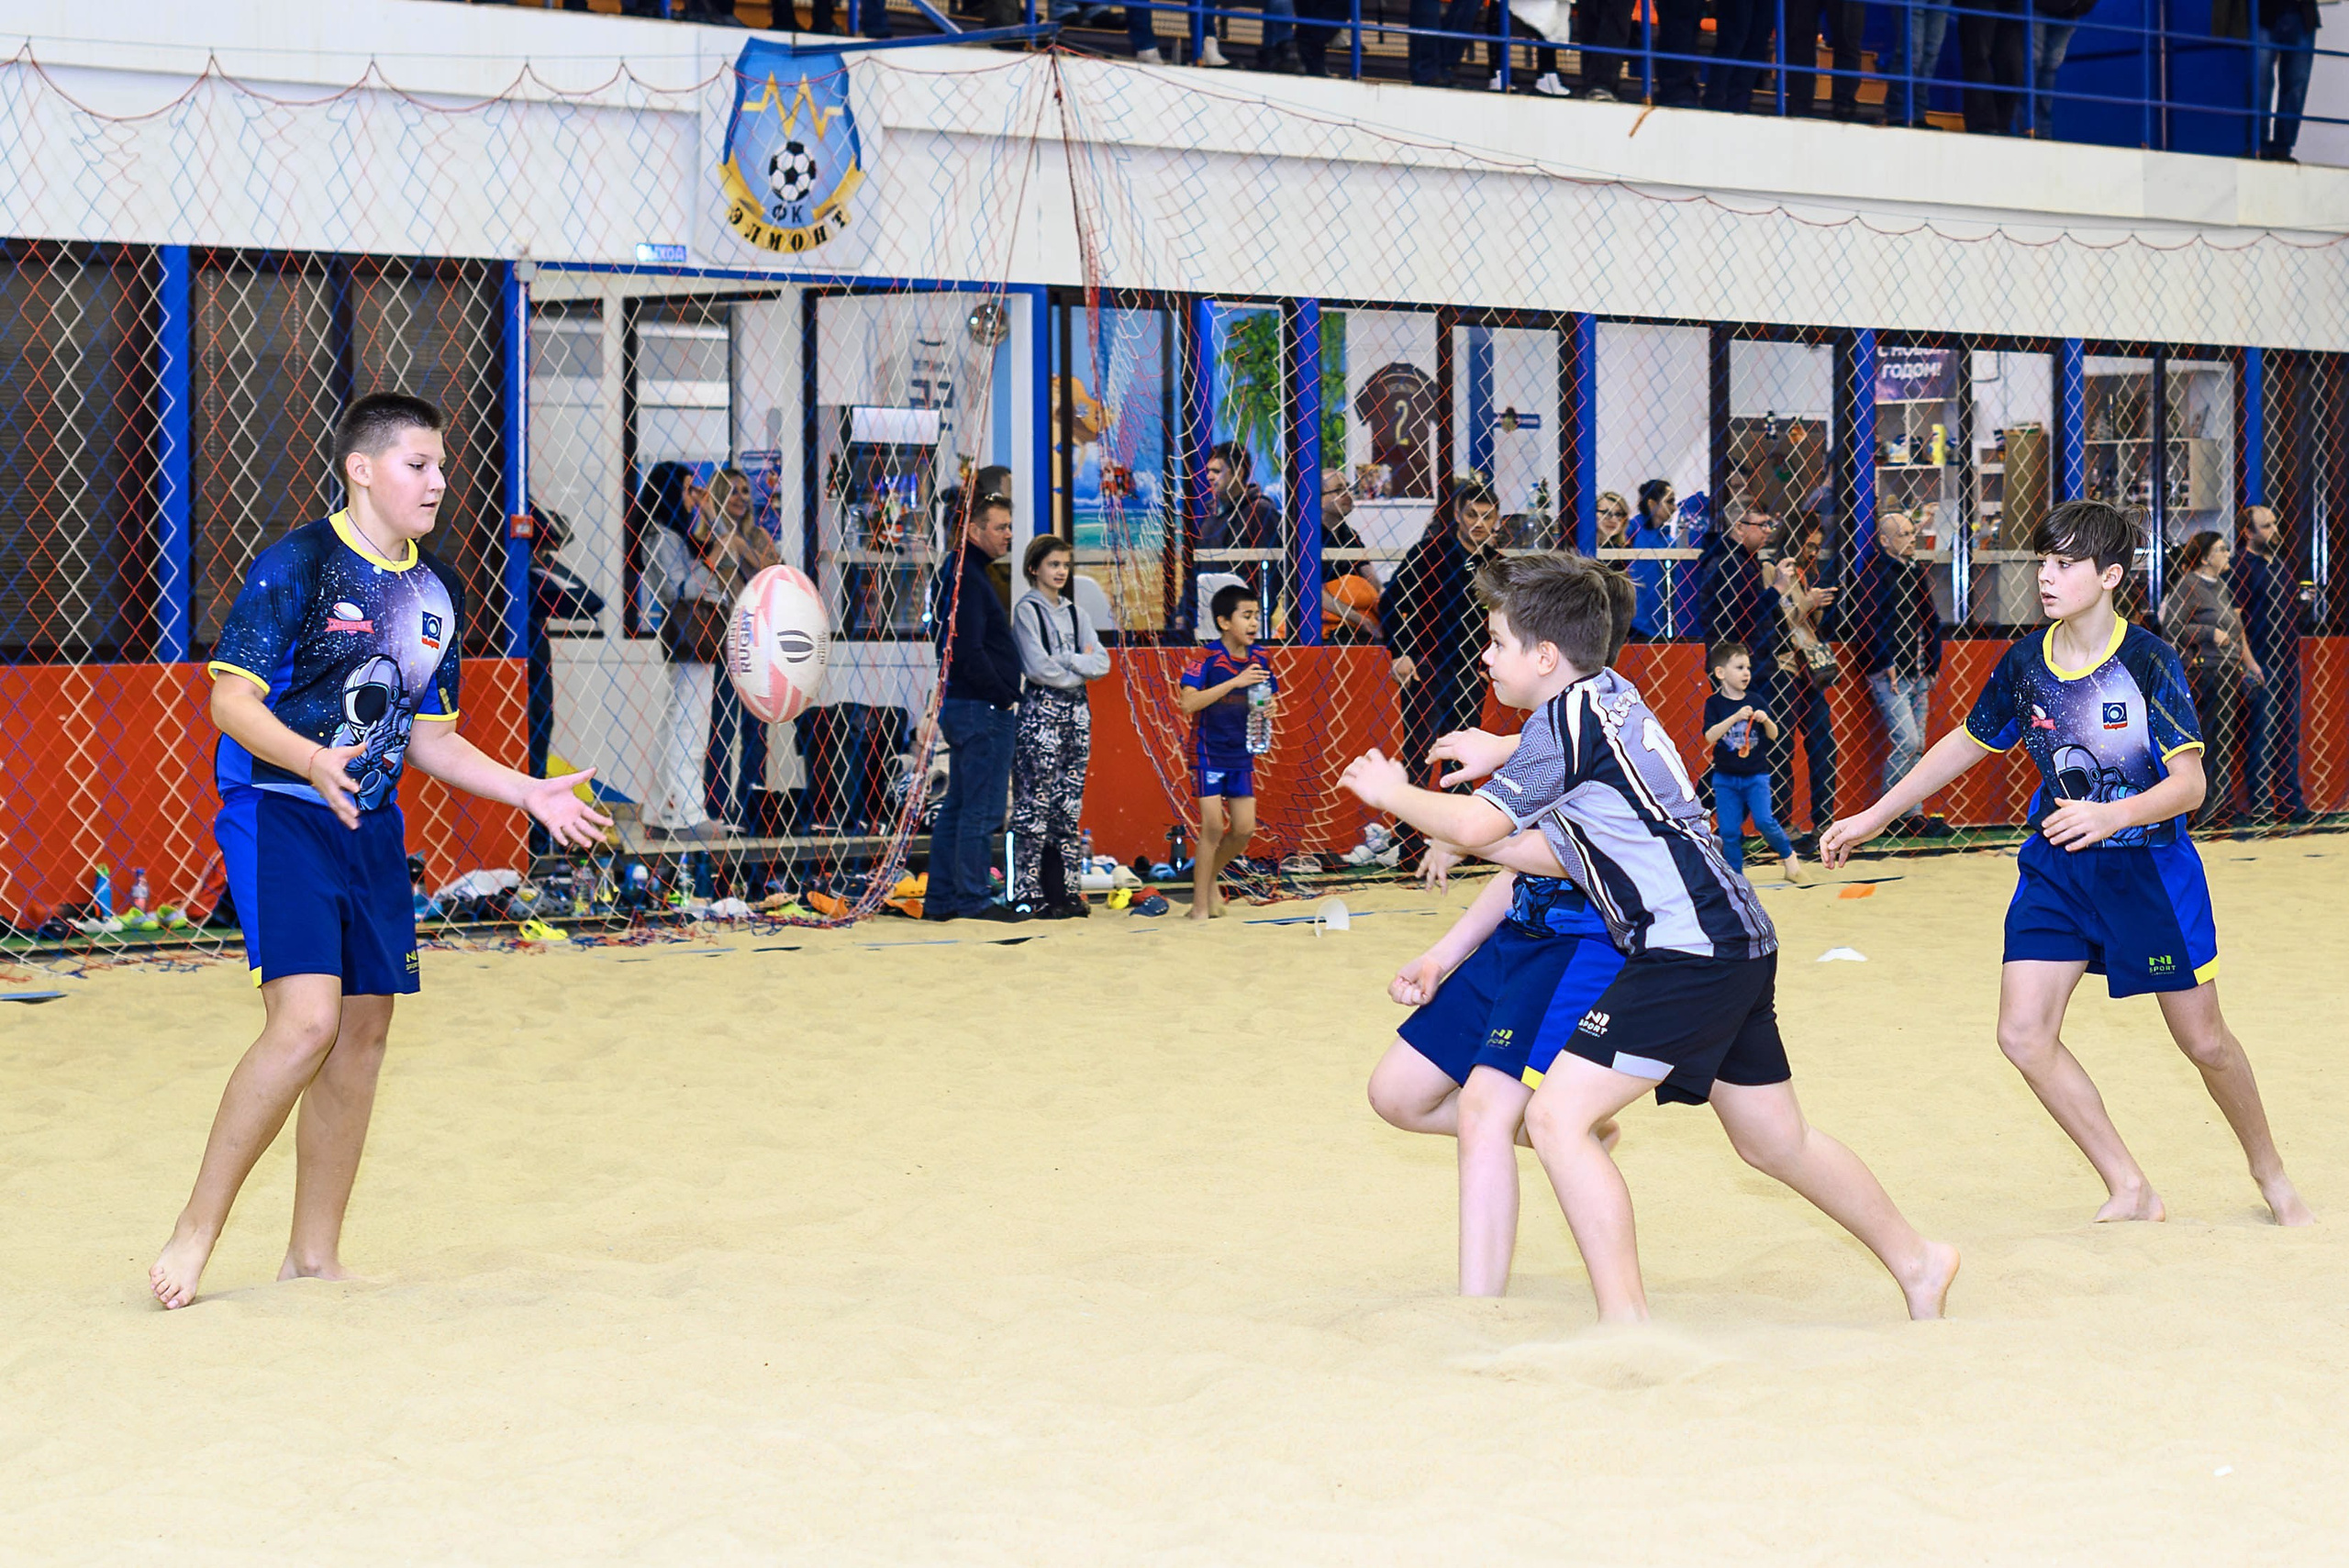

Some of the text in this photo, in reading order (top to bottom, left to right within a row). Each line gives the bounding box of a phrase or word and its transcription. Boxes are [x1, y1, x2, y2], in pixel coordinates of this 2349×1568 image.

[772, 204, 803, 224] ФК
[729, 206, 846, 251] ЭЛМОНТ
[1881, 361, 1943, 380] ГОДОМ!
[1394, 399, 1409, 446] 2
[739, 608, 756, 674] RUGBY
[2148, 964, 2176, 973] SPORT
[1577, 1018, 1609, 1036] SPORT
